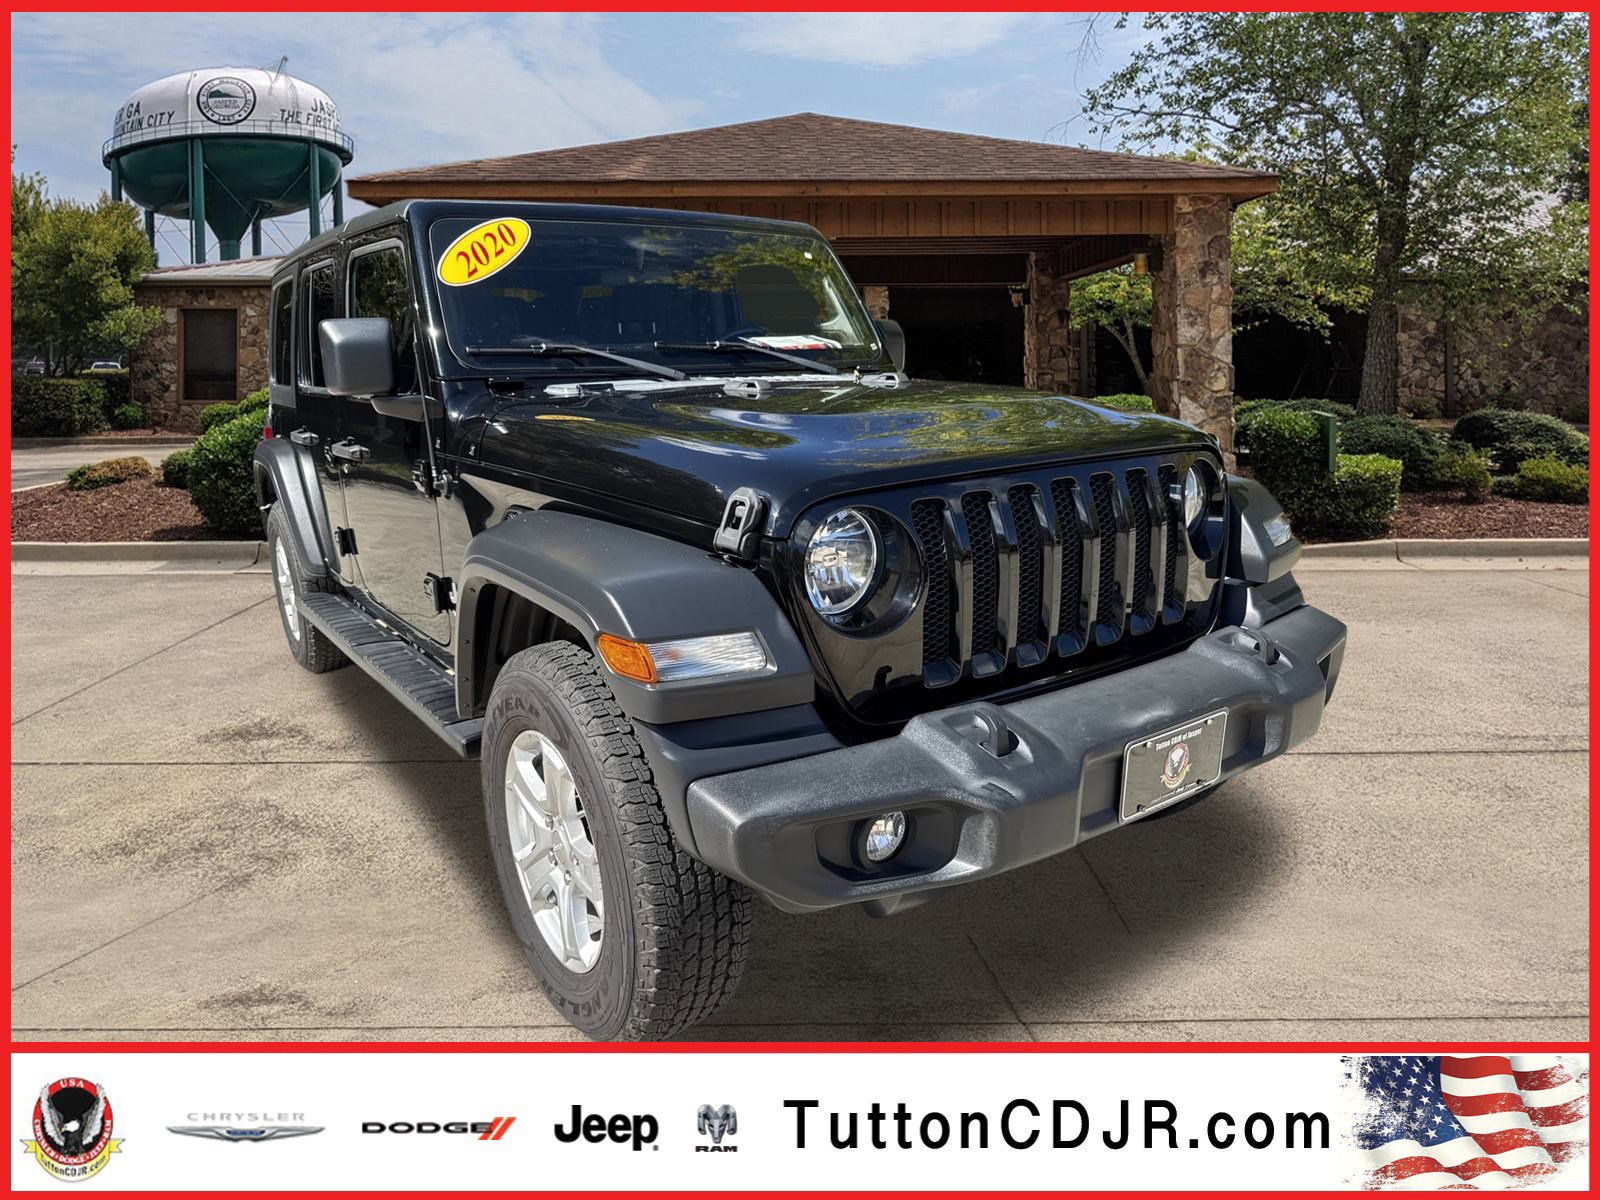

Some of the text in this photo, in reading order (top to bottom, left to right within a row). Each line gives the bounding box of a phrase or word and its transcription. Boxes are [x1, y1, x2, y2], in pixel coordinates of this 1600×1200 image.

[126, 100, 141, 119] GA
[147, 110, 175, 127] CITY
[280, 109, 302, 124] THE
[306, 112, 331, 129] FIRST
[456, 223, 516, 279] 2020
